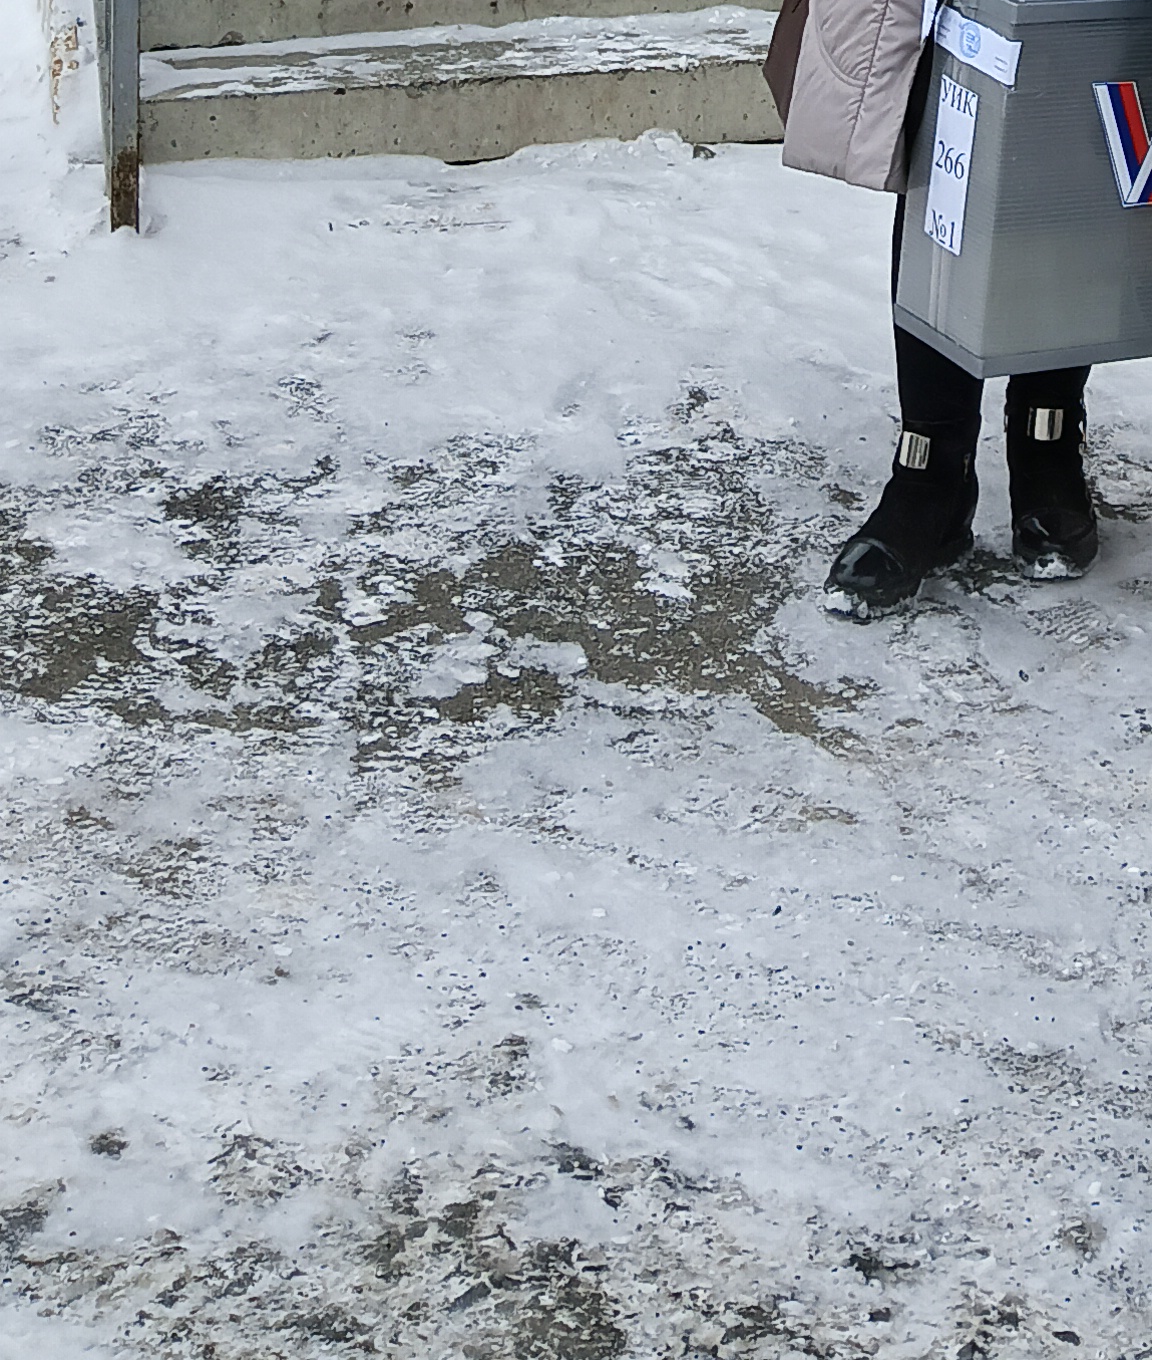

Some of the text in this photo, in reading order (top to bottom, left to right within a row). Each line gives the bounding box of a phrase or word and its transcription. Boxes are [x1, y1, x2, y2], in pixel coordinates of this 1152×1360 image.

[940, 77, 977, 119] УИК
[934, 139, 966, 181] 266
[928, 208, 956, 250] №1
